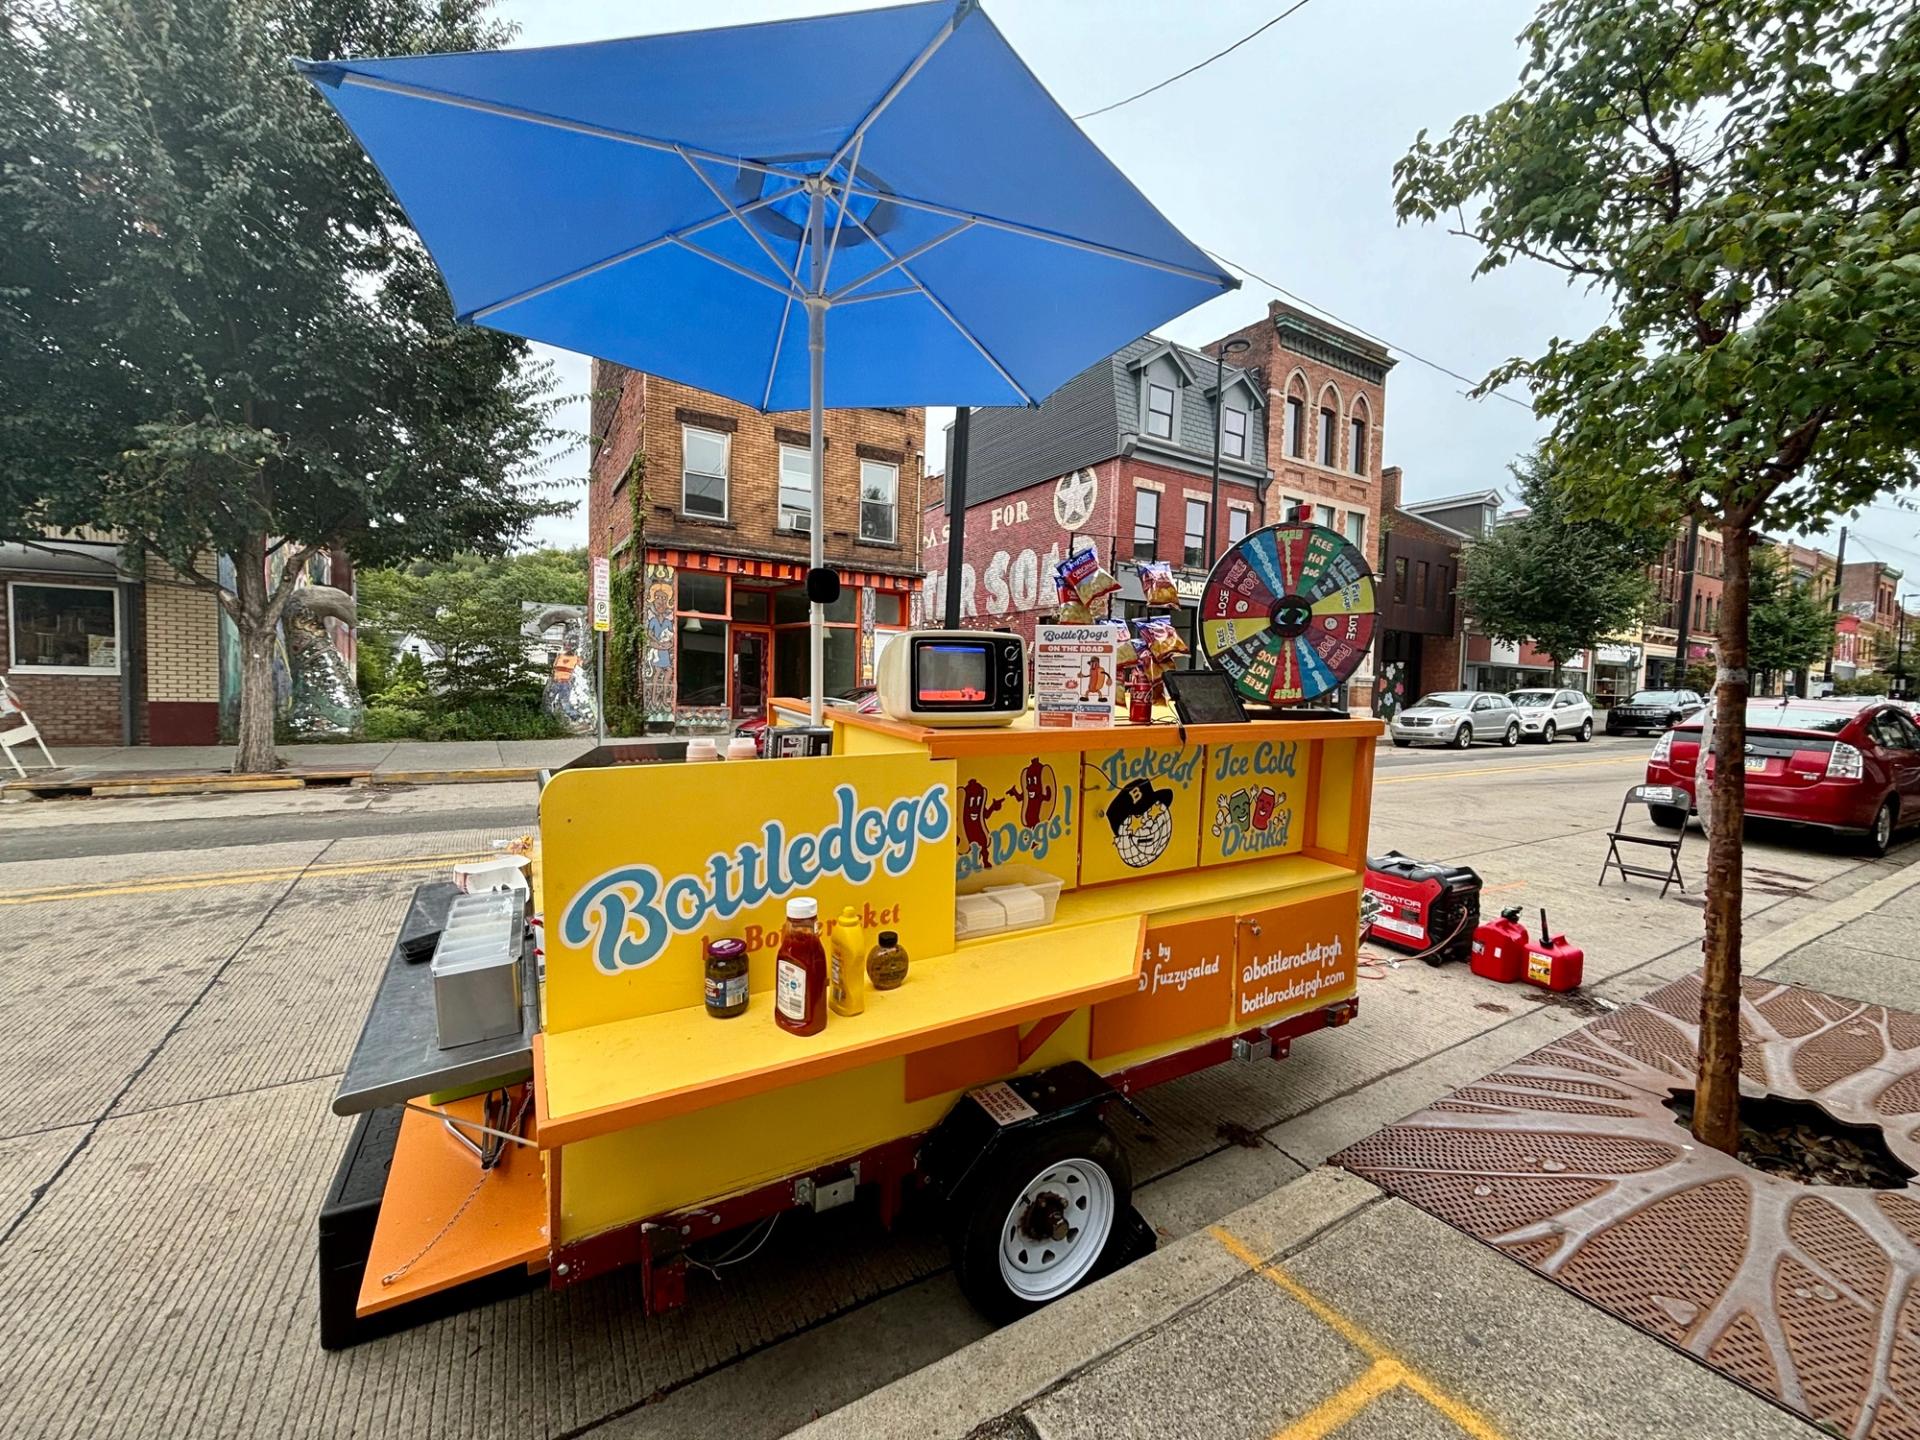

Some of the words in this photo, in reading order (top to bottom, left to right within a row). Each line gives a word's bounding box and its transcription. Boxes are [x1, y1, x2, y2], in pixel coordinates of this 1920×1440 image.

[990, 500, 1030, 532] FOR
[1310, 534, 1334, 552] FREE
[1307, 552, 1327, 566] HOT
[1223, 558, 1247, 588] FREE
[1237, 570, 1259, 596] POP
[1302, 566, 1320, 578] DOG
[1216, 589, 1230, 617] LOSE
[1345, 615, 1359, 640] LOSE
[1256, 650, 1278, 666] DOG
[1317, 634, 1337, 659] POP
[1248, 662, 1270, 679] HOT
[1243, 674, 1269, 695] FREE
[1101, 745, 1202, 792] Tickets!
[1215, 744, 1249, 782] Ice
[1253, 740, 1298, 778] Cold
[1128, 786, 1143, 804] B
[956, 841, 982, 880] ot
[991, 784, 1073, 866] Dogs!
[1221, 808, 1292, 857] Drinks!
[559, 783, 950, 976] Bottledogs
[1158, 942, 1171, 962] by
[1242, 934, 1343, 984] @bottlerocketpgh
[1151, 954, 1220, 995] fuzzysalad
[1241, 969, 1346, 1015] bottlerocketpgh.com
[994, 1091, 1004, 1100] DO
[1002, 1100, 1017, 1111] NOT
[1001, 1087, 1028, 1111] CAUTION
